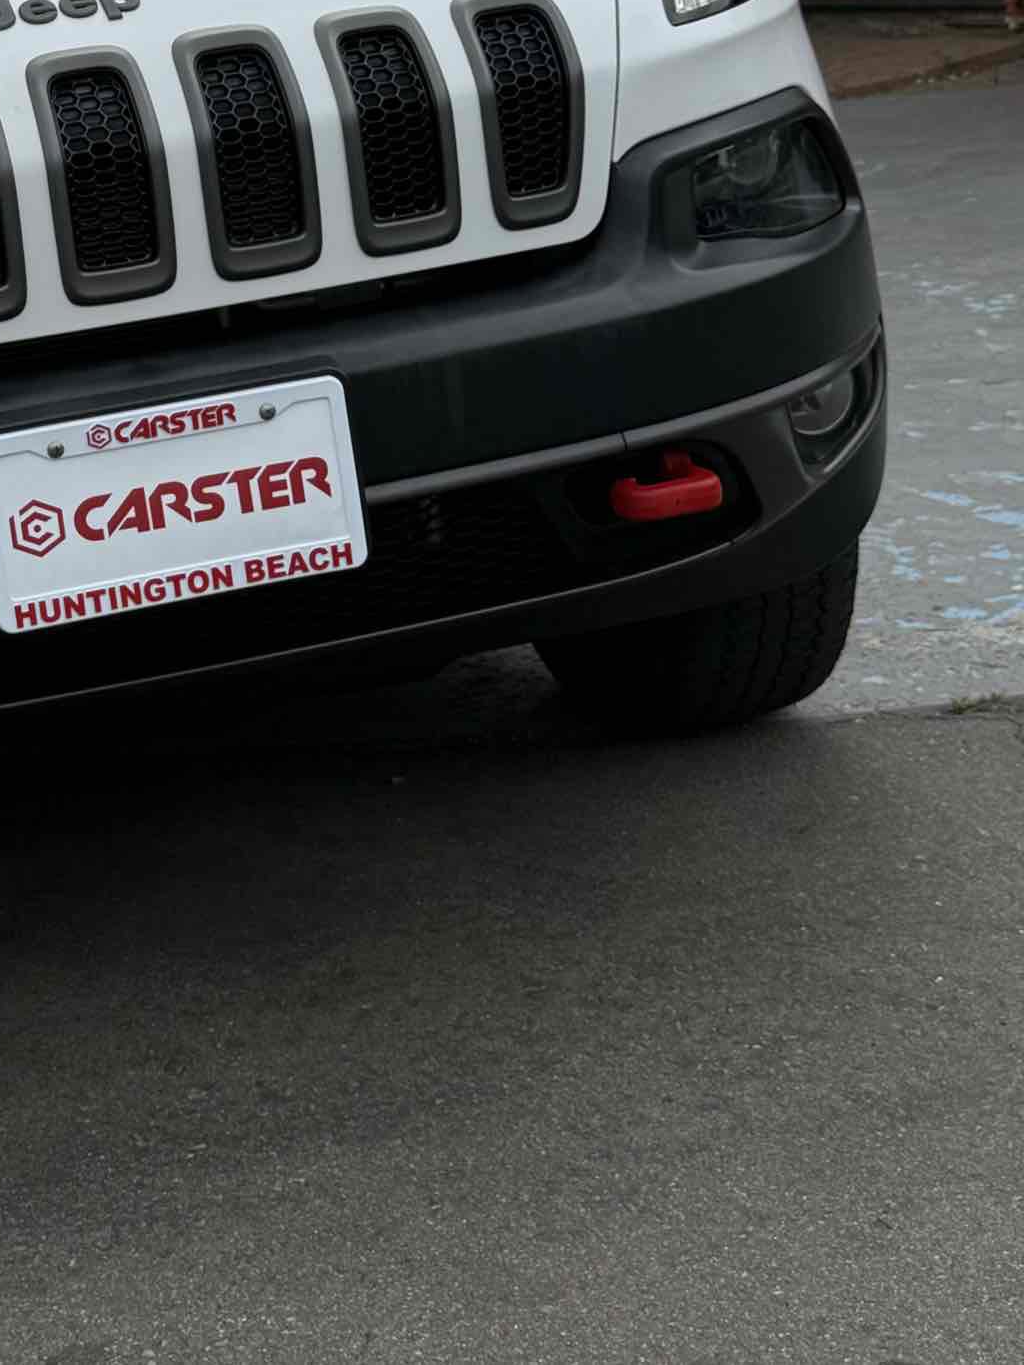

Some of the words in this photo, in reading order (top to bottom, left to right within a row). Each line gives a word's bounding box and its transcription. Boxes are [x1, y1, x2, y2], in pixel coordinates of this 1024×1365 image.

[114, 402, 237, 444] CARSTER
[74, 456, 333, 542] CARSTER
[14, 564, 234, 630] HUNTINGTON
[244, 542, 355, 584] BEACH
